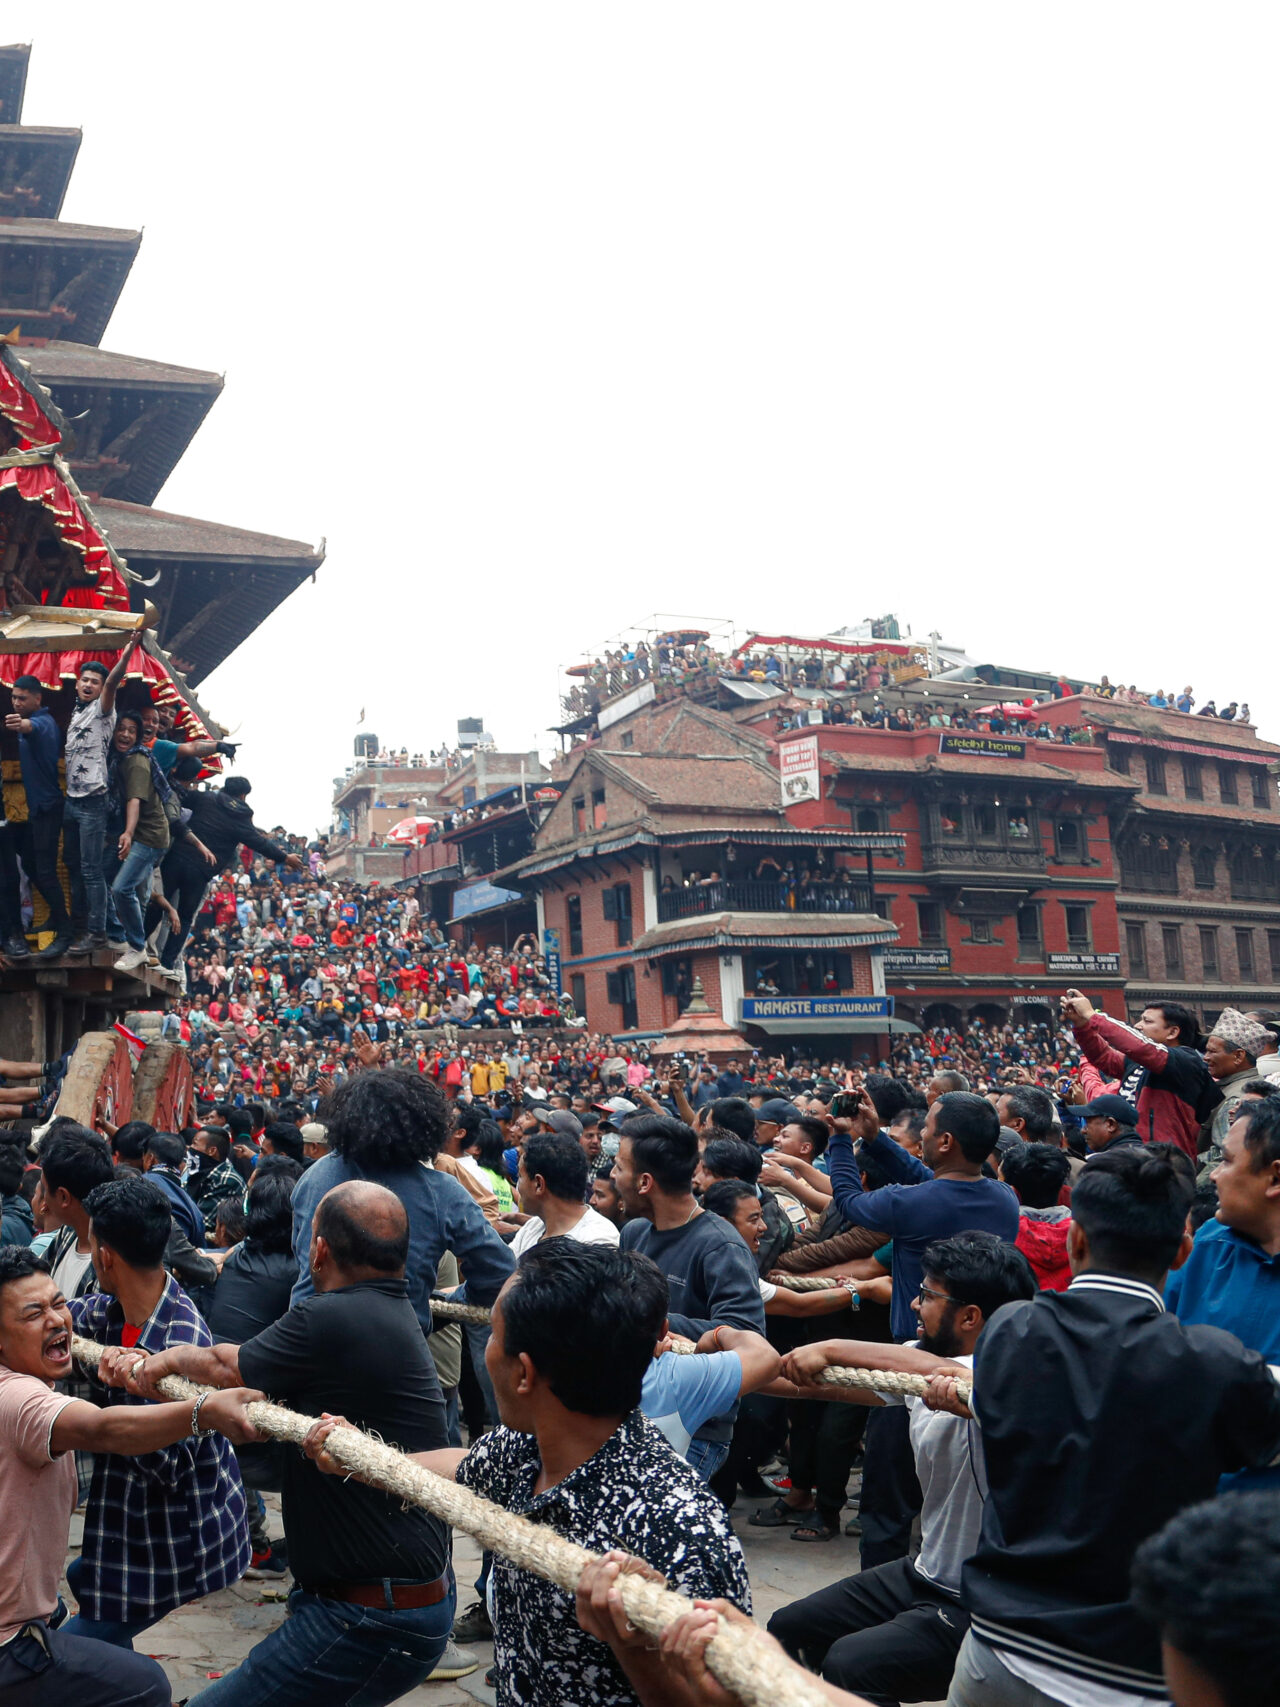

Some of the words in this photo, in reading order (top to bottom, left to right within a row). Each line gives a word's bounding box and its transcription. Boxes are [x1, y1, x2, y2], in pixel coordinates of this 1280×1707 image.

[988, 741, 1021, 752] home
[754, 1001, 811, 1016] NAMASTE
[814, 1003, 882, 1014] RESTAURANT
